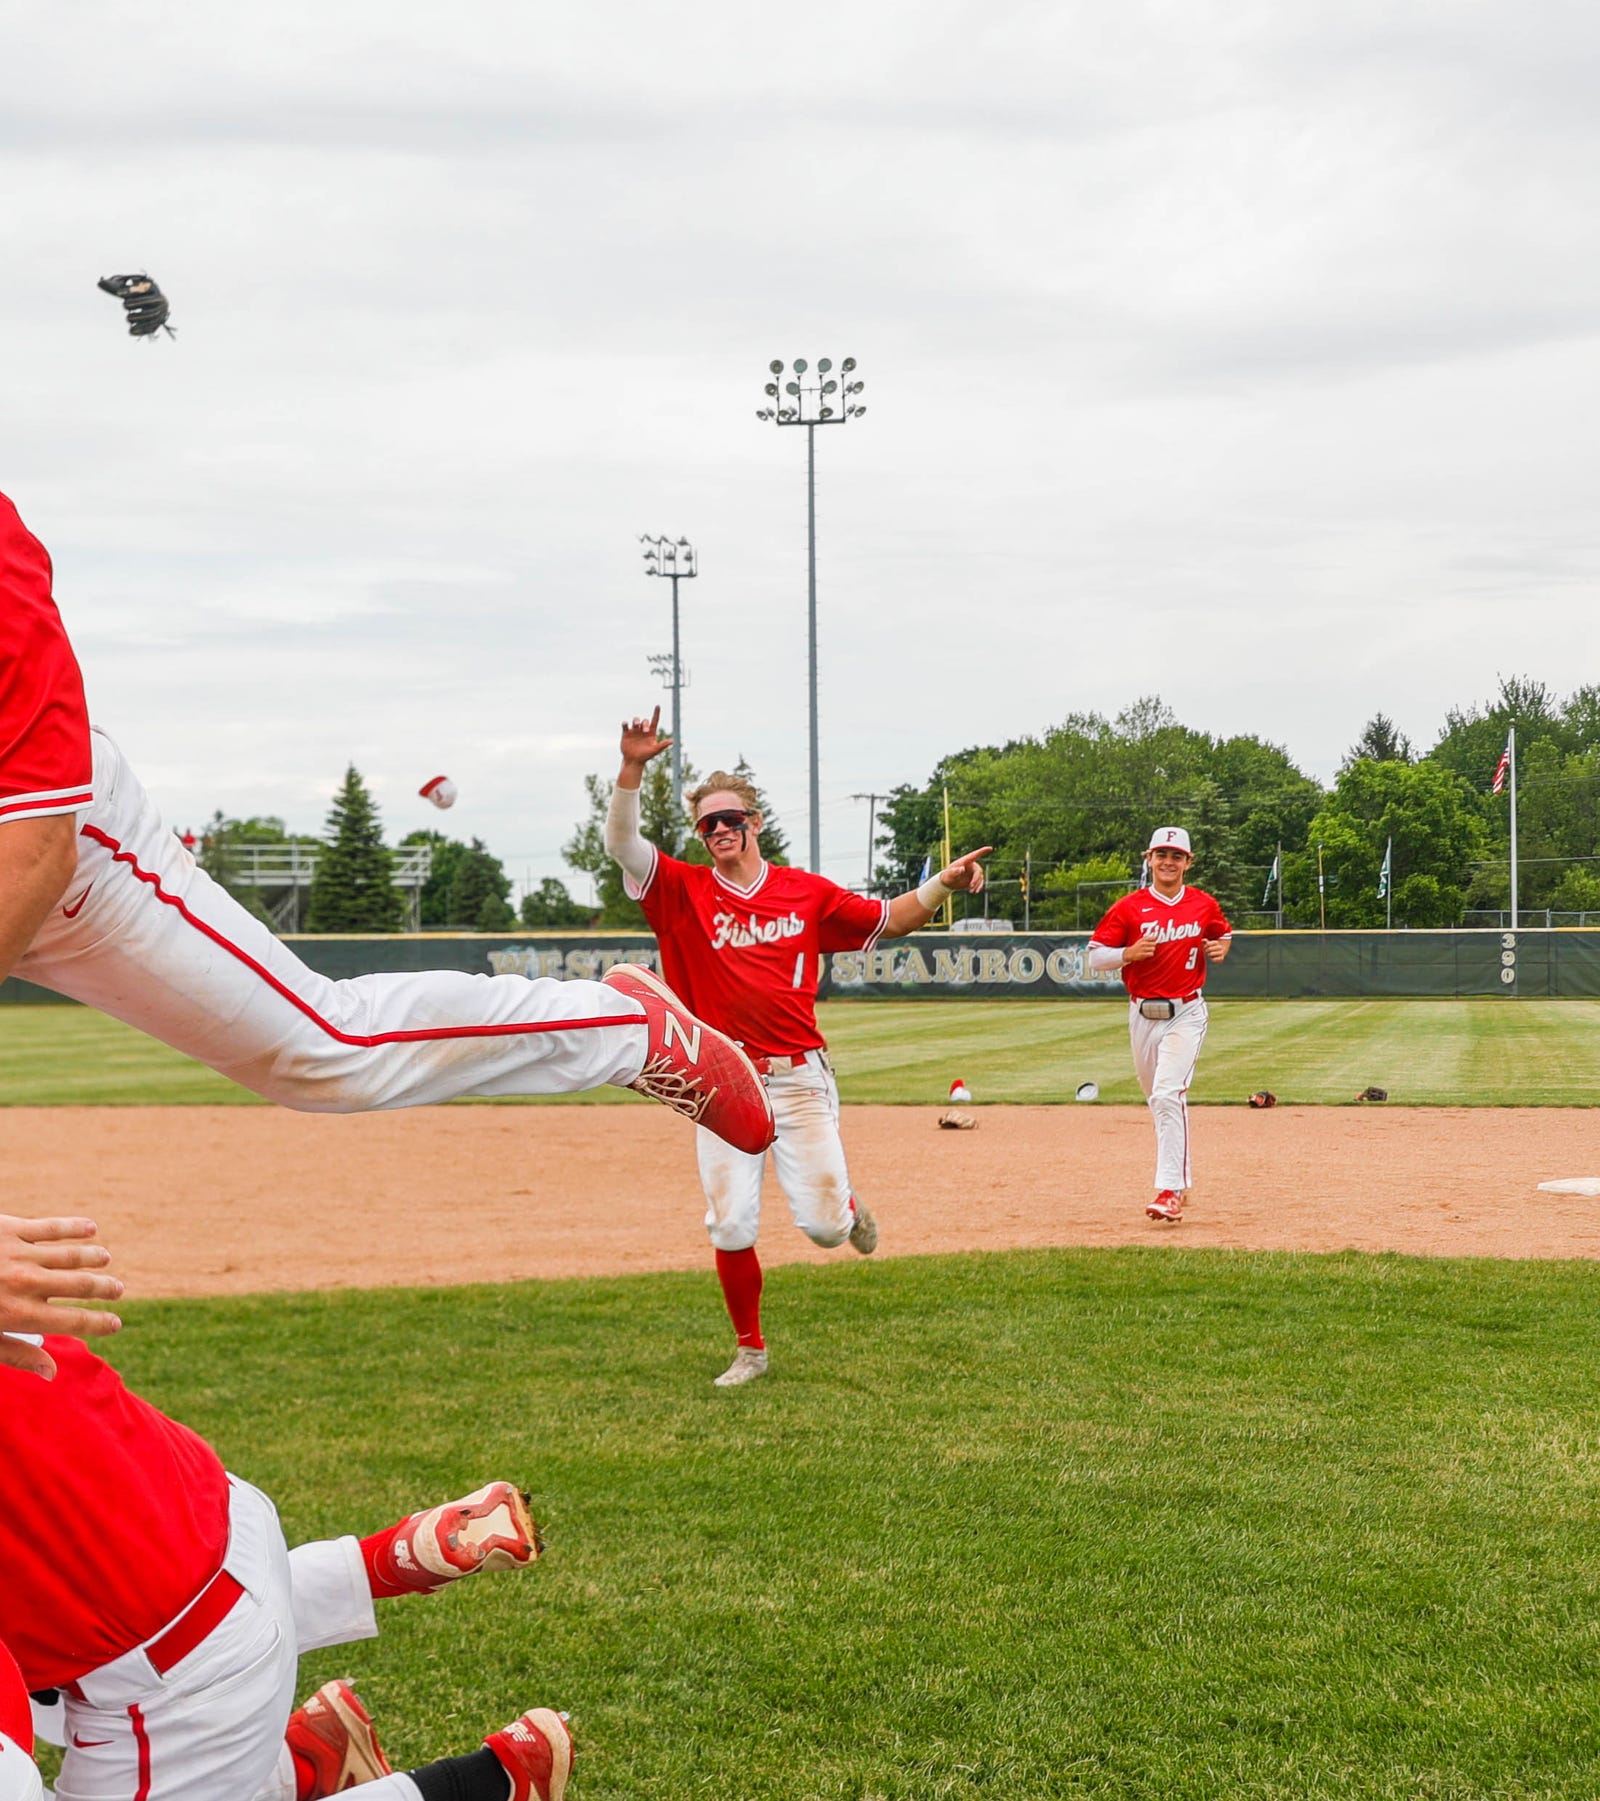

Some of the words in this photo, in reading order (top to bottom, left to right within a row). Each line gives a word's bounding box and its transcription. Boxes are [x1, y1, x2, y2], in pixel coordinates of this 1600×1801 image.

[1166, 831, 1177, 842] F
[711, 911, 805, 950] Fishers
[792, 952, 805, 989] 1
[1185, 947, 1198, 970] 3
[1501, 932, 1516, 984] 390
